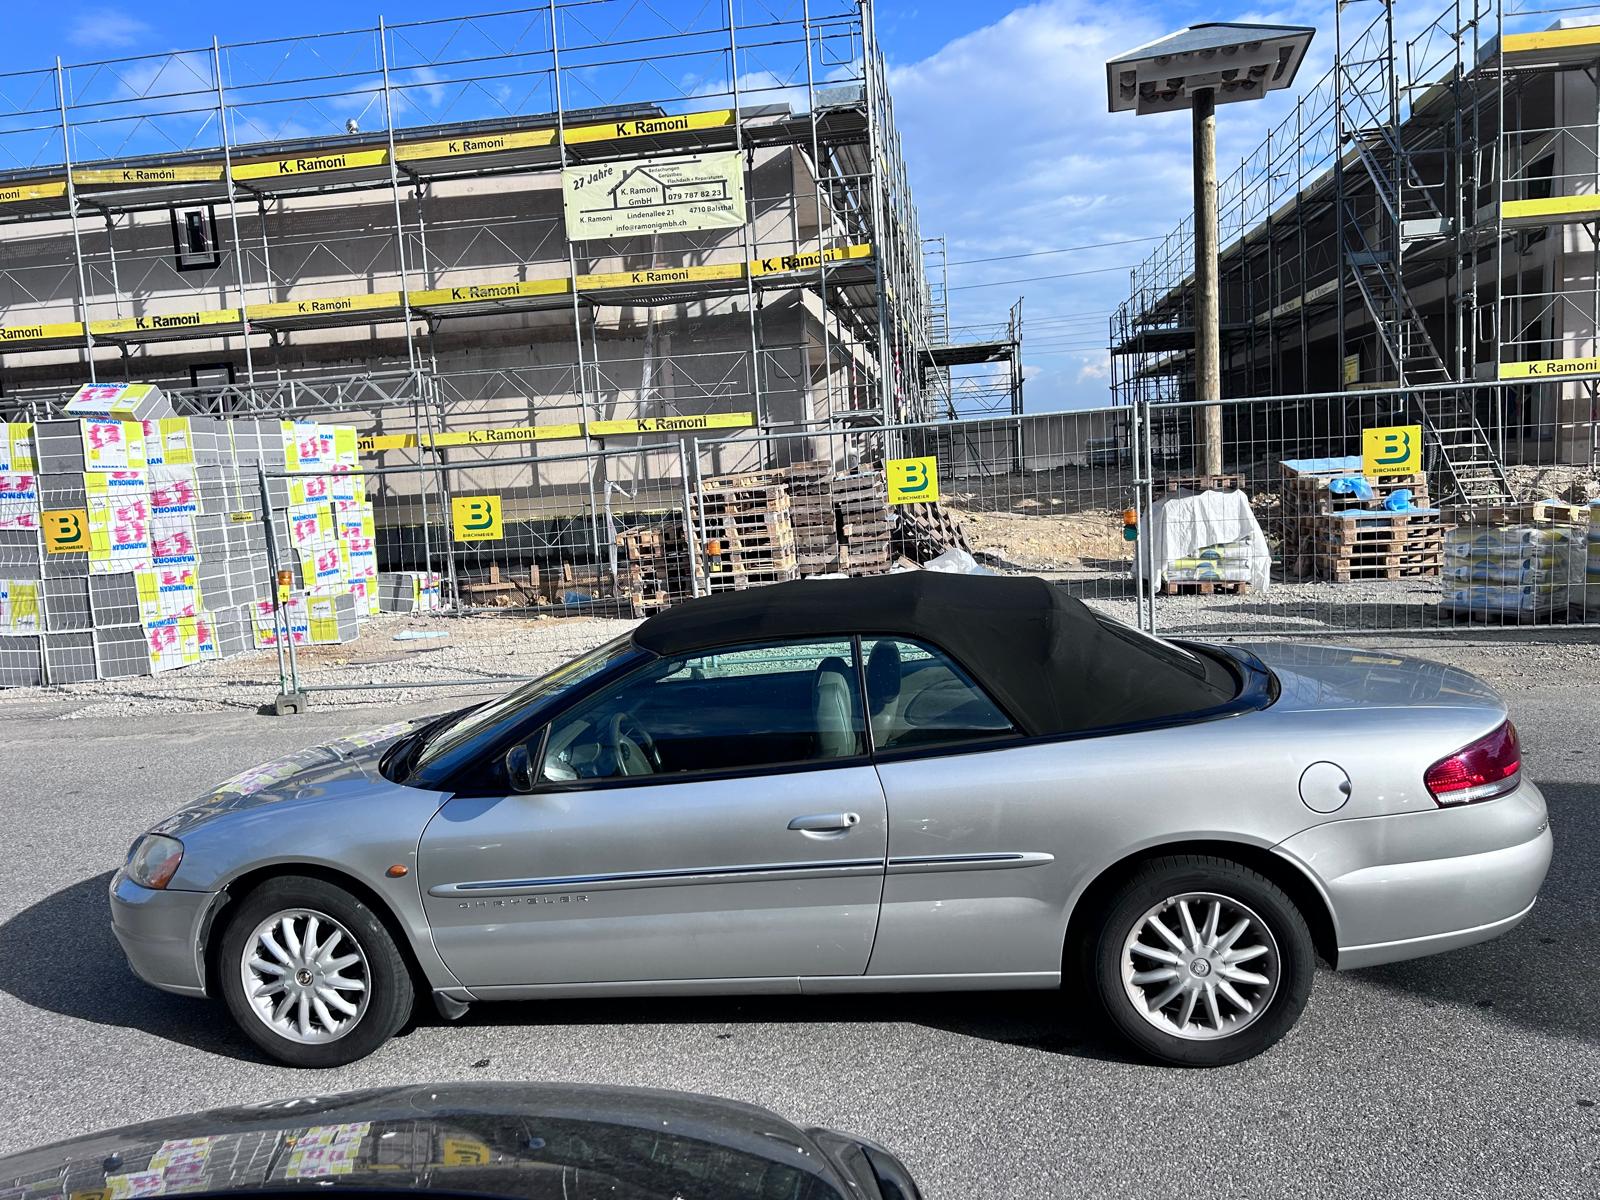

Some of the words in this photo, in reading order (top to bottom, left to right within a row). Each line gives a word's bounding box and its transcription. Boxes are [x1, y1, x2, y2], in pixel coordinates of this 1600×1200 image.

[616, 123, 631, 136] K.
[635, 116, 688, 134] Ramoni
[448, 142, 460, 152] K.
[463, 138, 504, 151] Ramoni
[279, 161, 293, 173] K.
[297, 155, 346, 172] Ramoni
[123, 171, 133, 180] K.
[136, 170, 175, 180] Ramoni
[573, 178, 584, 190] 27
[587, 166, 614, 184] Jahre
[630, 186, 658, 194] Ramoni
[700, 190, 710, 198] 82
[628, 198, 652, 206] GmbH
[689, 206, 706, 214] 4710
[707, 204, 734, 212] Balsthal
[627, 210, 666, 219] Lindenallee
[616, 220, 687, 232] info@ramonigmbh.ch
[762, 258, 777, 272] K.
[781, 250, 835, 270] Ramoni
[632, 273, 644, 282] K.
[647, 270, 689, 282] Ramoni
[452, 288, 466, 300] K.
[470, 284, 520, 298] Ramoni
[298, 302, 309, 312] K.
[312, 298, 351, 311] Ramoni
[136, 318, 149, 330] K.
[153, 313, 200, 328] Ramoni
[0, 326, 42, 339] Ramoni
[1529, 364, 1542, 374] K.
[1546, 360, 1597, 373] Ramoni
[637, 418, 652, 431] K.
[655, 416, 707, 430] Ramoni
[468, 430, 484, 442] K.
[487, 426, 536, 440] Ramoni
[458, 896, 589, 908] CHRYSLER
